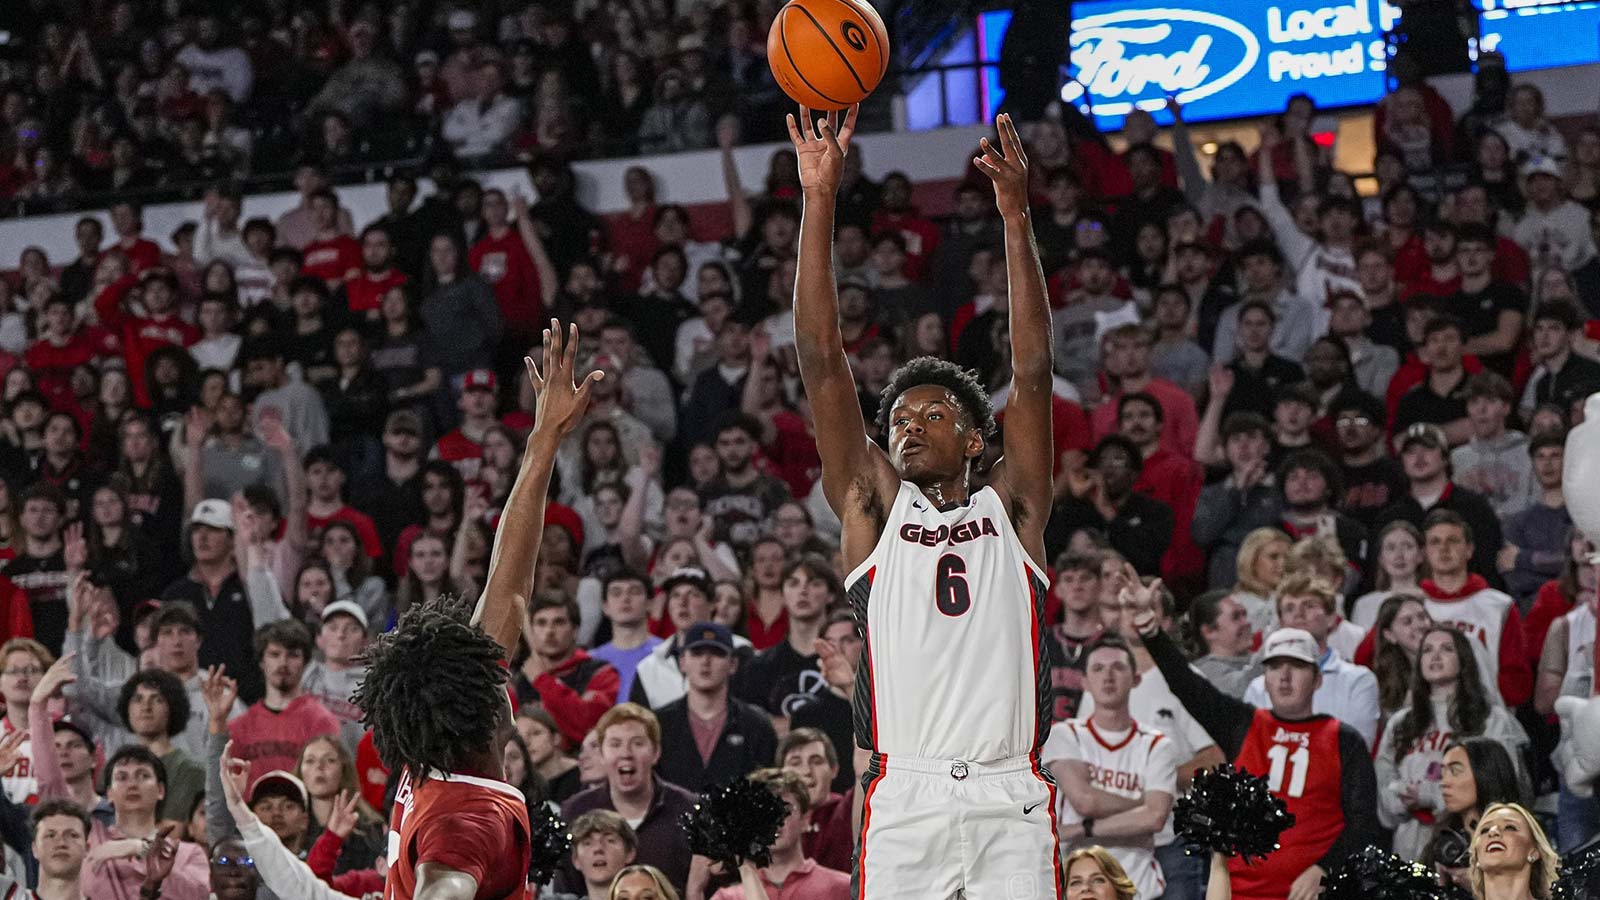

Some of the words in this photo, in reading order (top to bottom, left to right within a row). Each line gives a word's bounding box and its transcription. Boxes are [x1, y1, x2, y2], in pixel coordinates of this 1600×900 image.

[840, 20, 868, 53] G
[1267, 0, 1372, 43] Local
[1070, 22, 1212, 98] Ford
[1268, 42, 1364, 82] Proud
[934, 552, 981, 617] 6
[1266, 743, 1310, 798] 11
